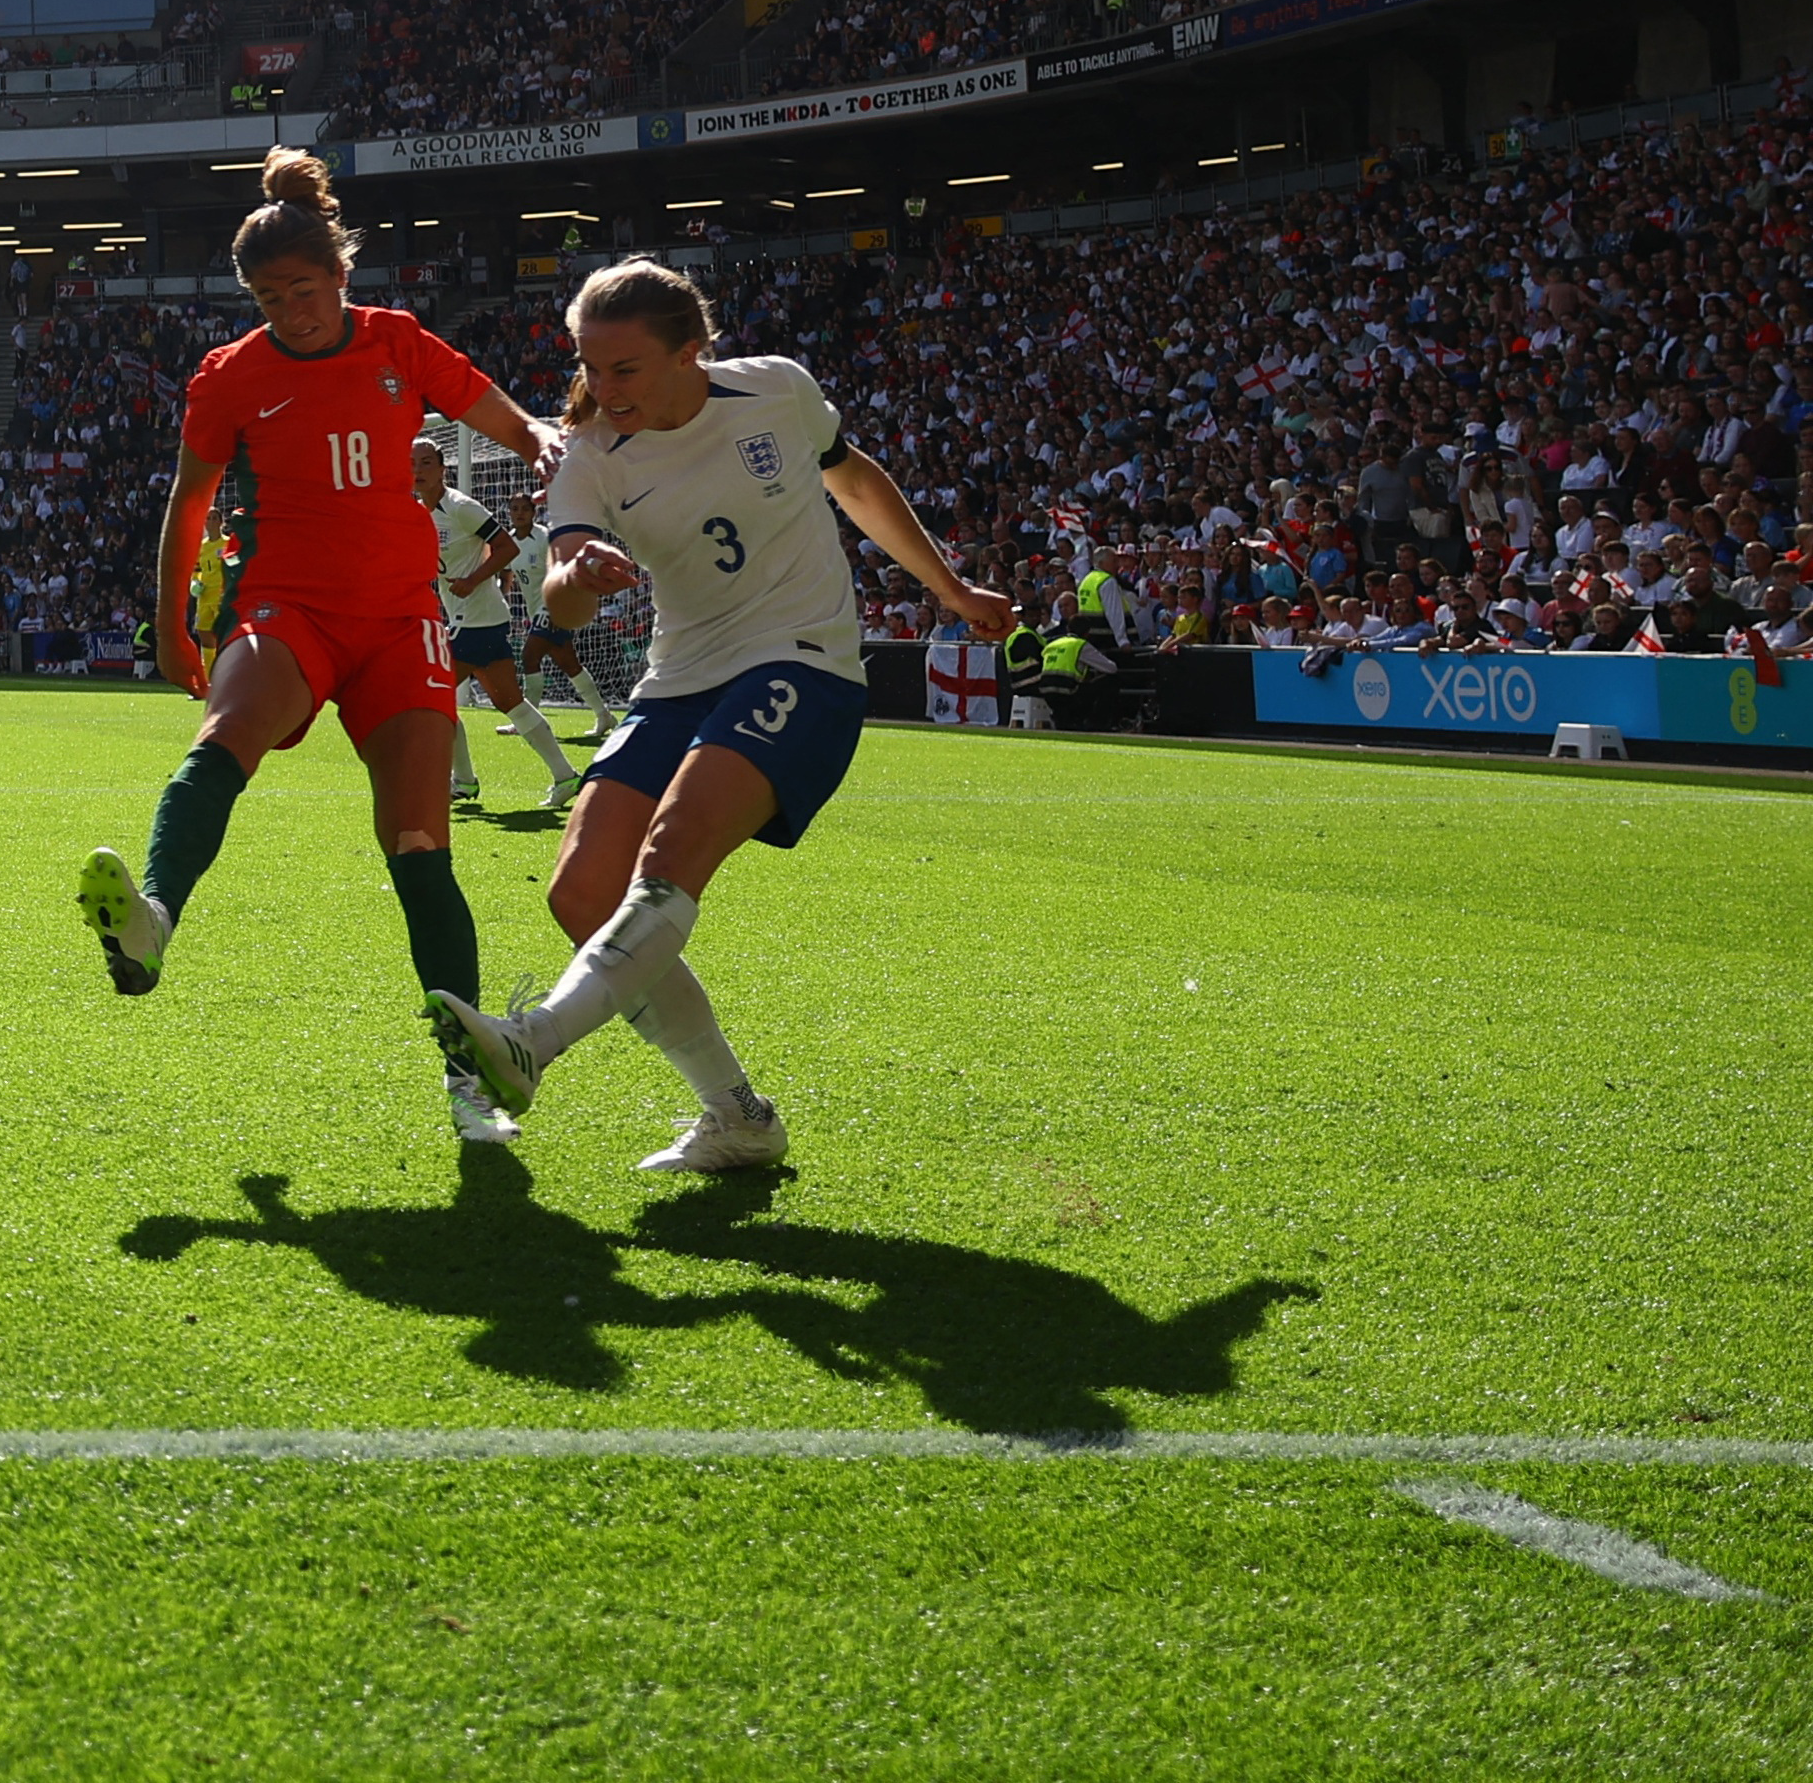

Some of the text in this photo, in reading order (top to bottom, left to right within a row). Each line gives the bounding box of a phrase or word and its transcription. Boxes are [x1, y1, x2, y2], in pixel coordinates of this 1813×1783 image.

[1173, 14, 1221, 50] EMW
[1230, 16, 1247, 35] Be
[1254, 0, 1319, 31] anything
[259, 52, 295, 72] 27A
[1037, 41, 1165, 81] ABLE TO TACKLE ANYTHING...
[697, 114, 735, 135] JOIN
[740, 110, 770, 128] THE
[846, 83, 950, 114] TOGETHER
[954, 78, 975, 97] AS
[980, 69, 1018, 91] ONE
[392, 121, 602, 156] A GOODMAN & SON
[410, 142, 585, 170] METAL RECYCLING
[1492, 138, 1506, 156] 30
[1440, 158, 1463, 173] 24
[59, 285, 75, 297] 27
[417, 268, 433, 282] 28
[327, 430, 371, 490] 18
[702, 516, 746, 574] 3
[535, 615, 549, 628] 16
[422, 619, 451, 672] 18
[753, 679, 798, 733] 3
[1357, 681, 1387, 698] xero
[1420, 664, 1537, 722] xero
